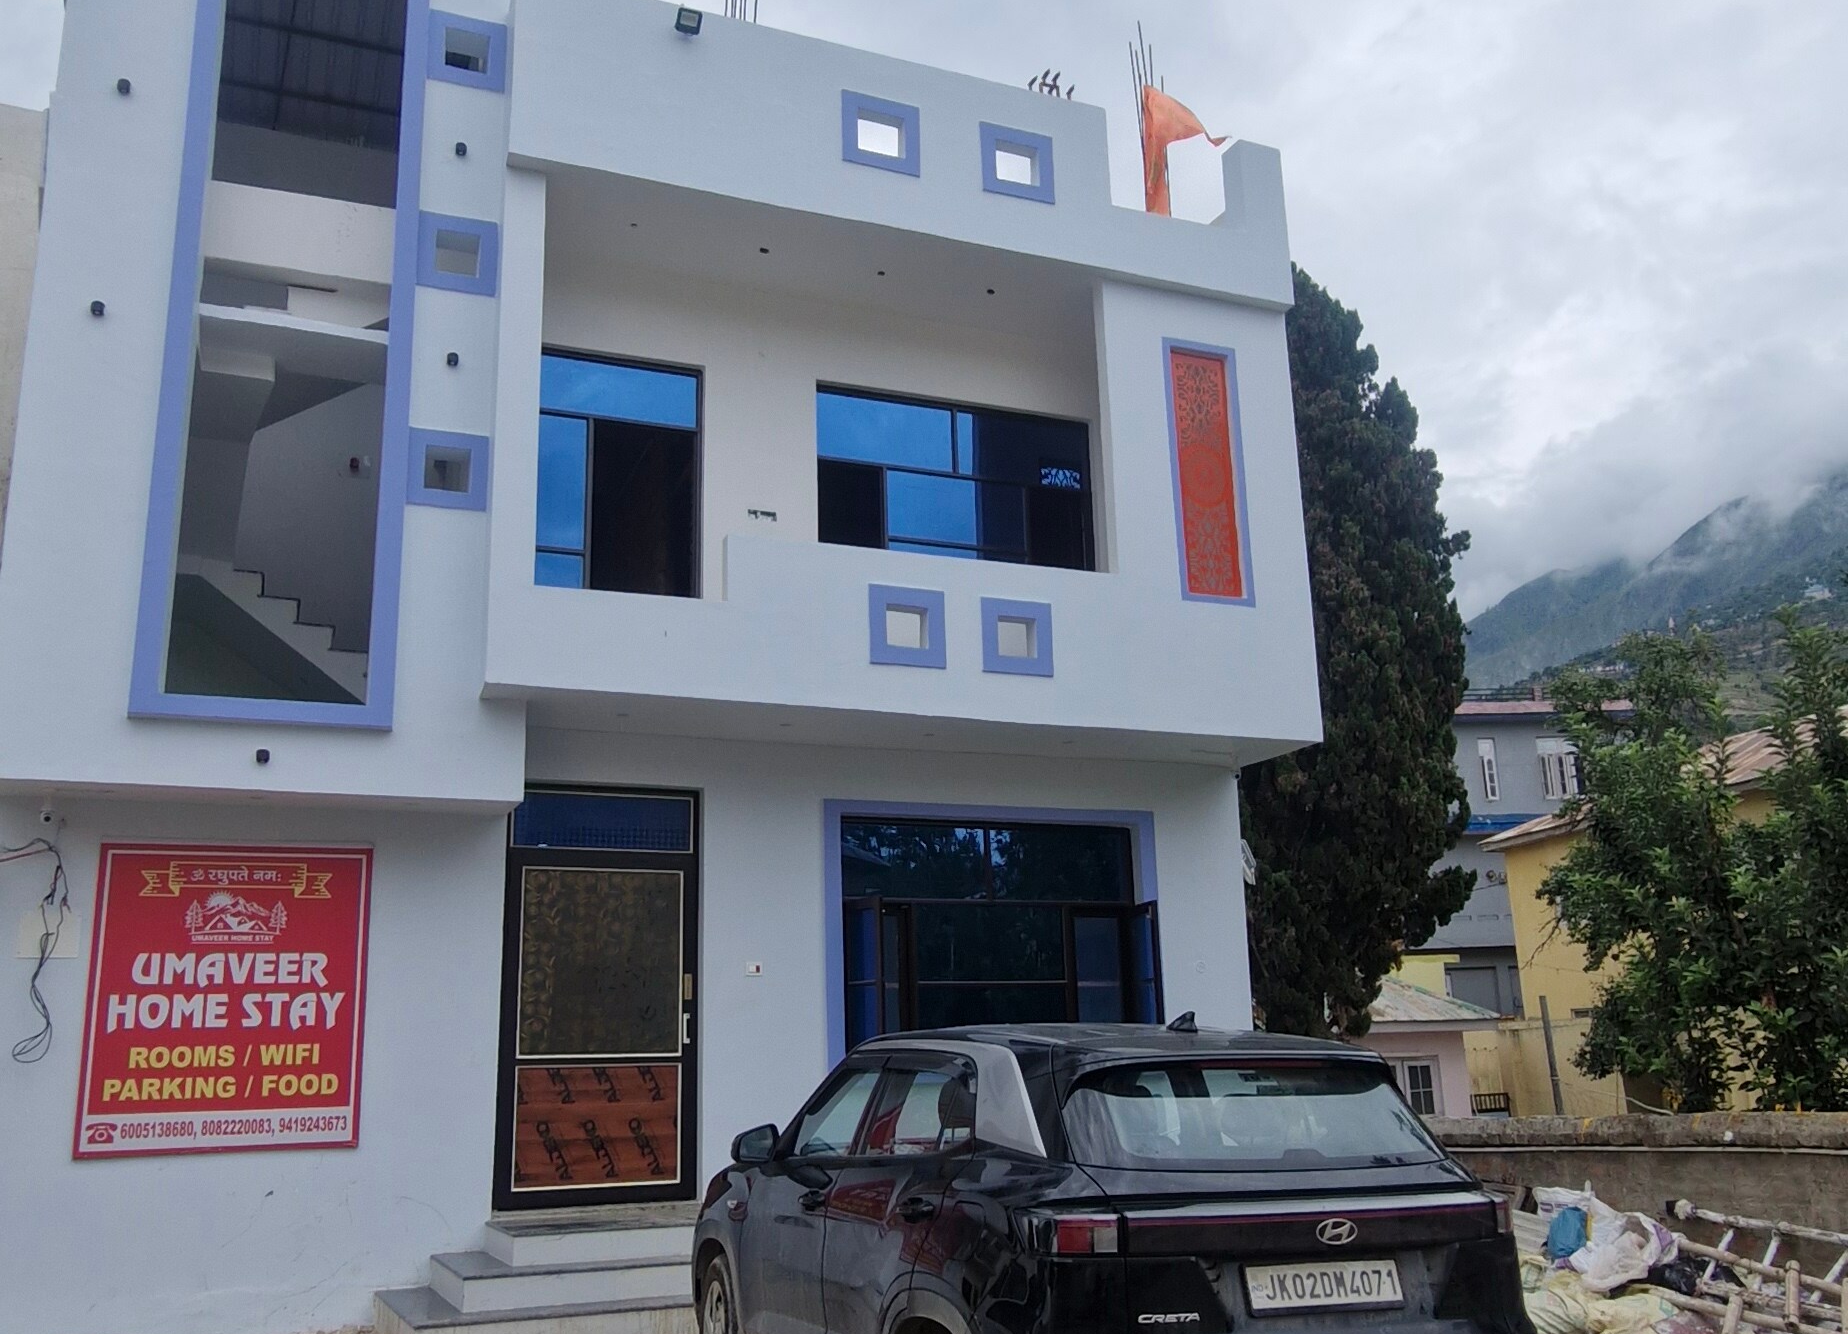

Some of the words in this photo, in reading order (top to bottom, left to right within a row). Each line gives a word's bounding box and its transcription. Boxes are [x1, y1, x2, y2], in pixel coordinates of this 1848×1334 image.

[207, 866, 249, 885] रघुपते
[253, 870, 282, 882] नमः
[191, 934, 229, 942] UMAVEER
[231, 934, 253, 942] HOME
[255, 934, 275, 942] STAY
[131, 952, 329, 989] UMAVEER
[106, 993, 230, 1035] HOME
[241, 991, 346, 1031] STAY
[128, 1045, 236, 1069] ROOMS
[259, 1043, 321, 1066] WIFI
[102, 1075, 238, 1102] PARKING
[261, 1073, 339, 1097] FOOD
[120, 1121, 197, 1140] 6005138680,
[201, 1118, 276, 1137] 8082220083,
[278, 1115, 348, 1133] 9419243673
[1266, 1269, 1398, 1301] JK02DM4071
[1137, 1312, 1201, 1324] CRETA
